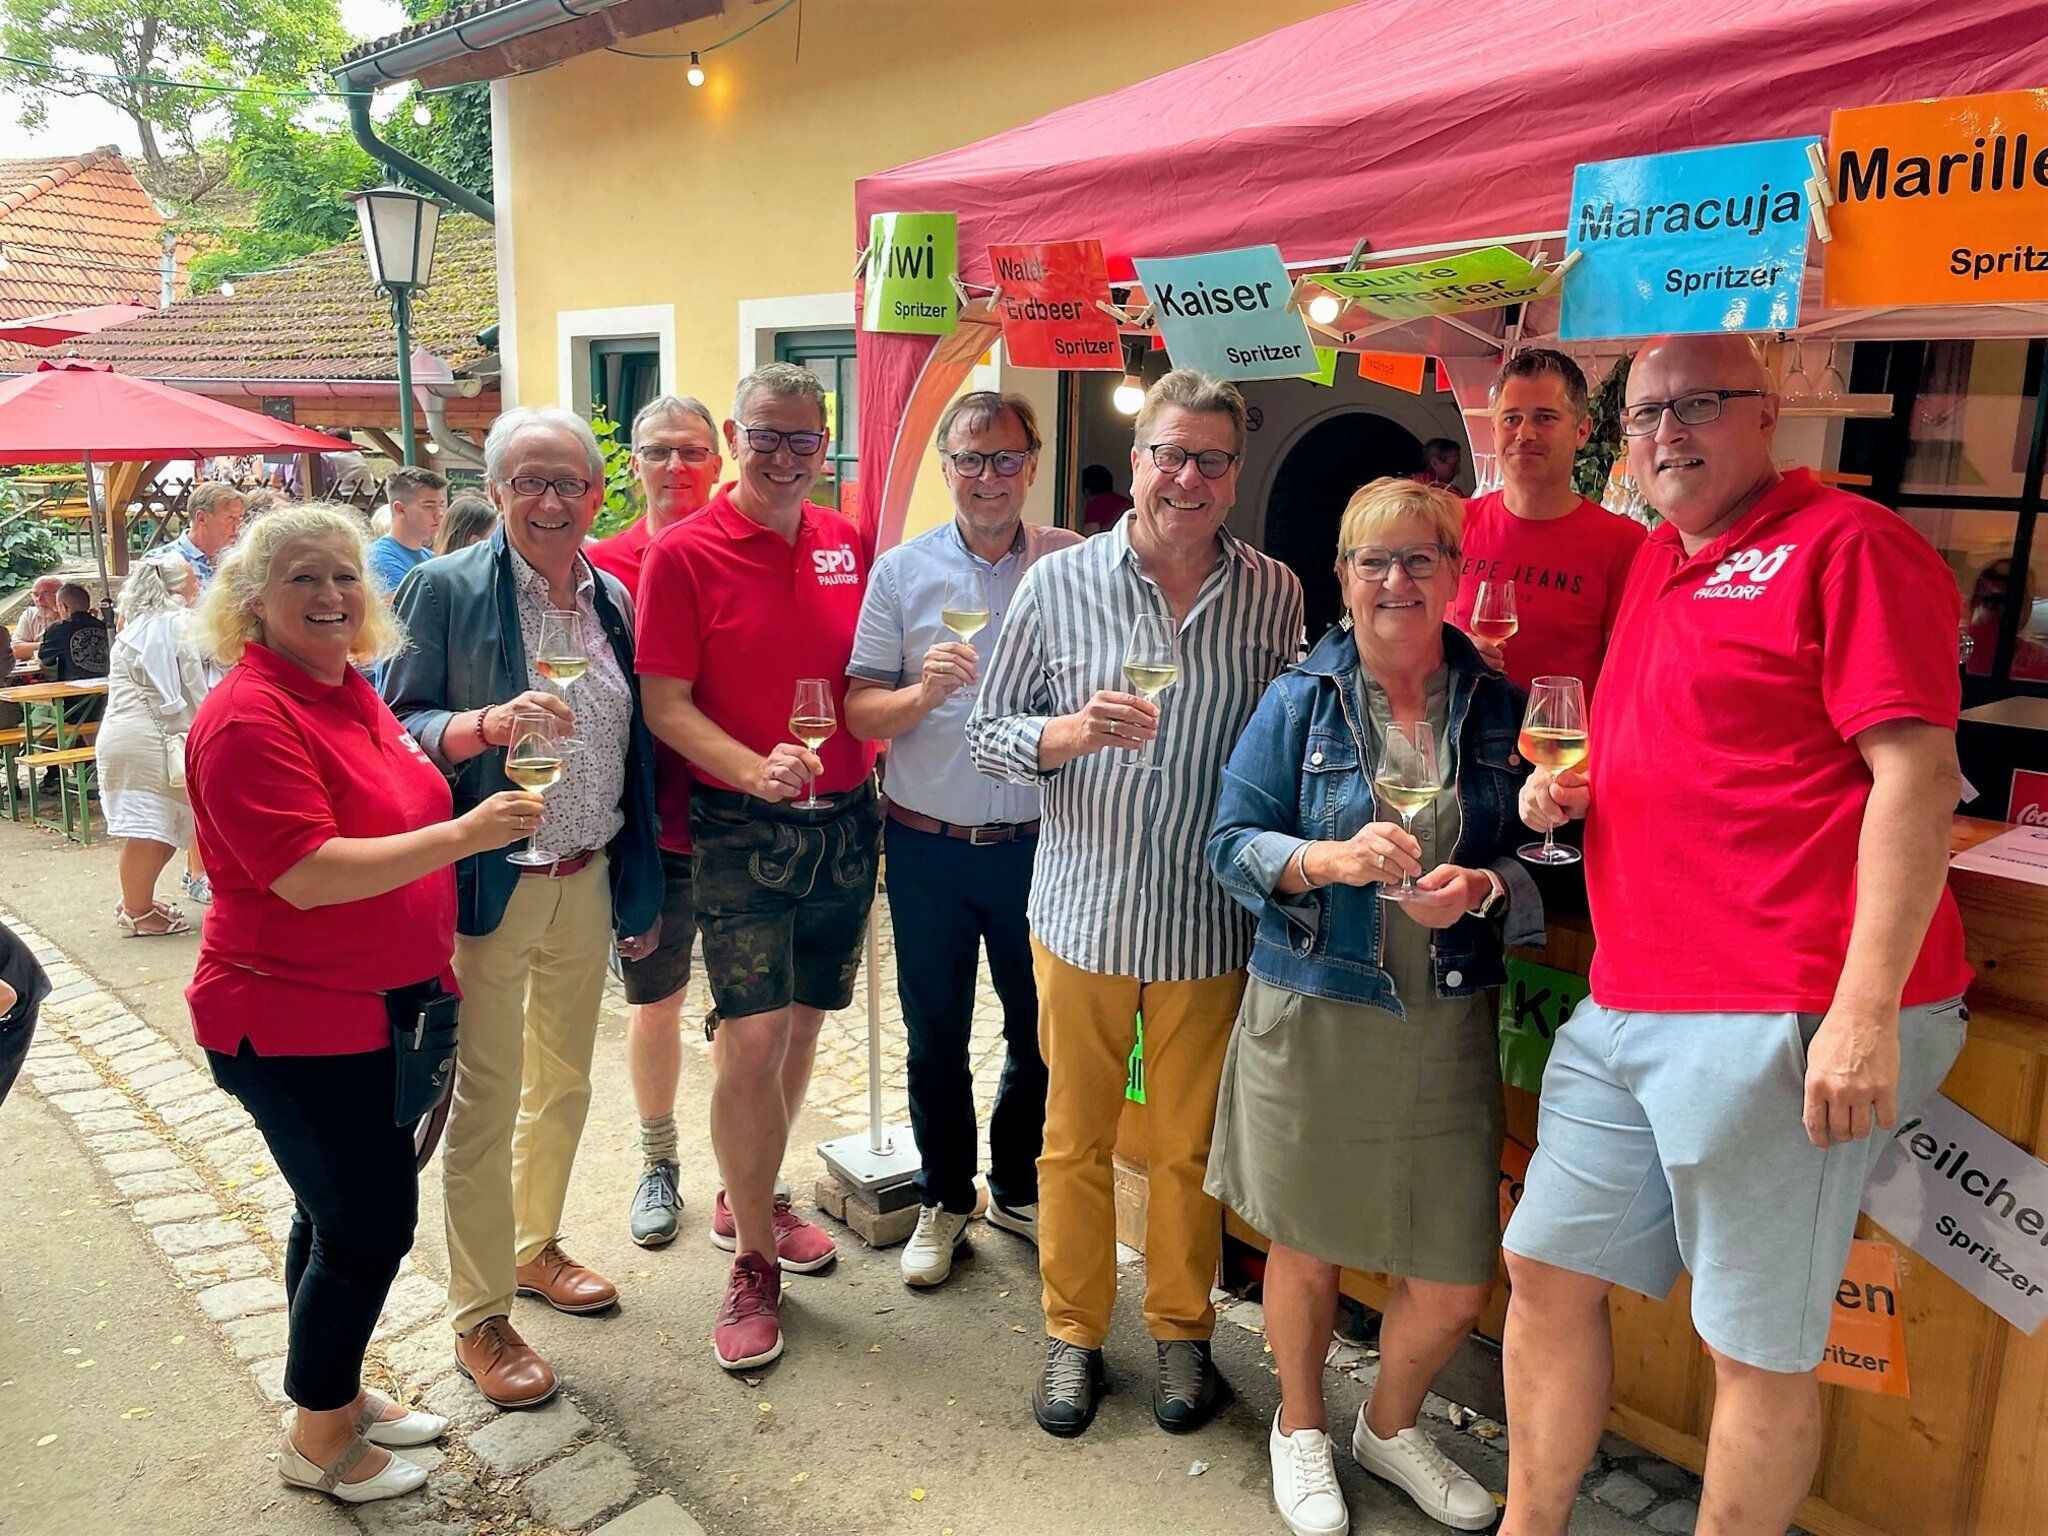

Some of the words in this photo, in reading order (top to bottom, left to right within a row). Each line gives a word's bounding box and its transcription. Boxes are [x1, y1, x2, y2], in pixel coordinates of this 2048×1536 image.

[1578, 183, 1801, 243] Maracuja
[1333, 266, 1458, 289] Gurke
[1368, 278, 1506, 305] Pfeffer
[1664, 265, 1783, 298] Spritzer
[894, 301, 948, 319] Spritzer
[1005, 297, 1084, 321] Erdbeer
[1154, 280, 1272, 317] Kaiser
[1055, 338, 1115, 358] Spritzer
[1226, 345, 1302, 367] Spritzer
[812, 543, 856, 574] SPÖ
[1705, 544, 1797, 586] SPÖ
[1512, 564, 1583, 595] JEANS
[1894, 1117, 2048, 1247] eilche
[1935, 1215, 2044, 1297] Spritzer
